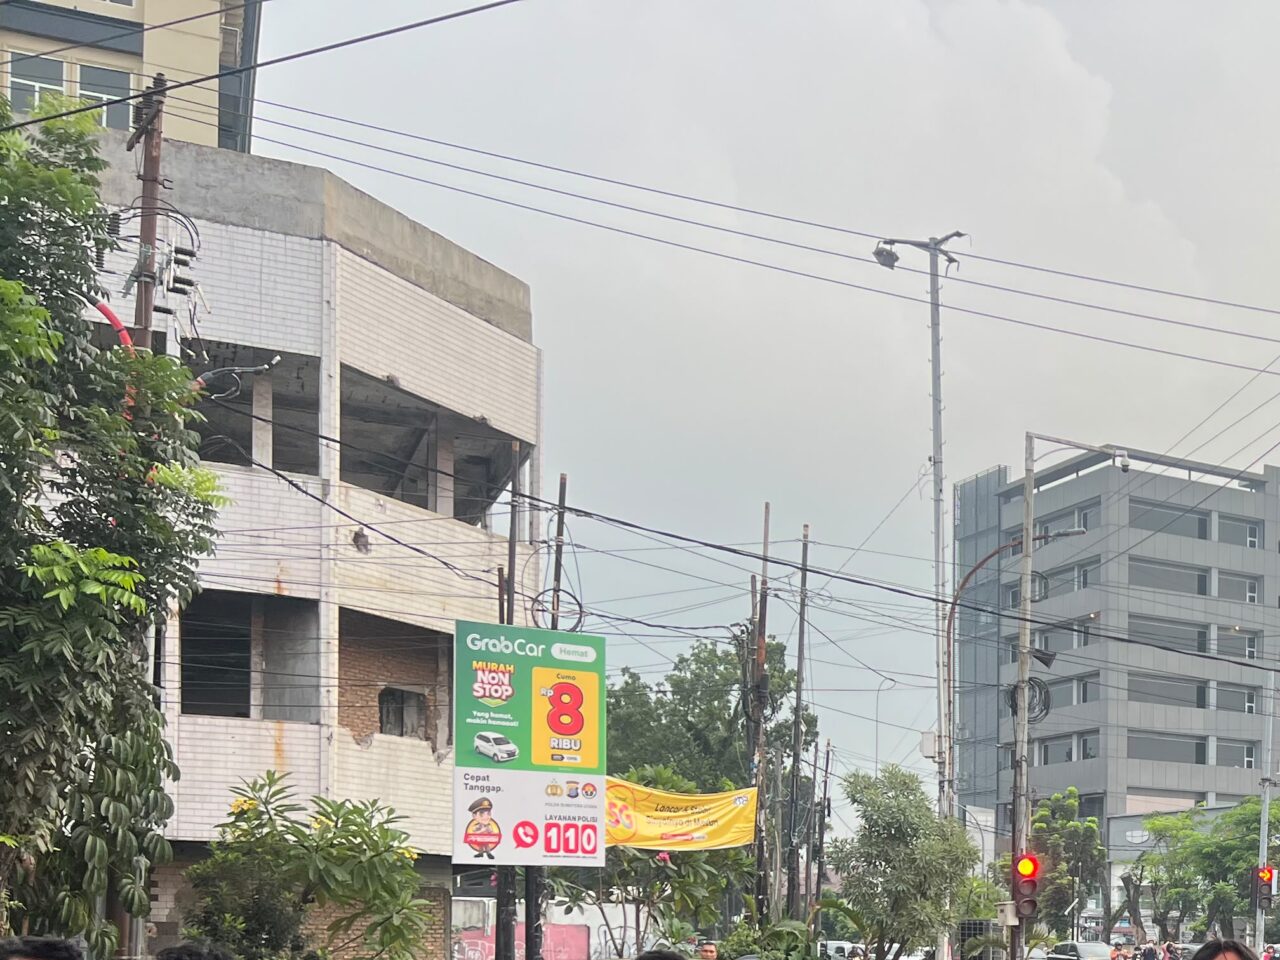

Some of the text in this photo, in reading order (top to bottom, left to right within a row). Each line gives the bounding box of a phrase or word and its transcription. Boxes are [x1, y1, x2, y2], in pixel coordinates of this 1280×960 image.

[466, 633, 588, 658] GrabCar Hemat
[472, 660, 514, 674] MURAH
[477, 671, 510, 685] NON
[472, 684, 514, 700] STOP
[547, 682, 584, 736] 8
[550, 737, 582, 751] RIBU
[463, 773, 490, 782] Cepat
[544, 814, 598, 823] LAYANAN POLISI
[546, 826, 596, 851] 110
